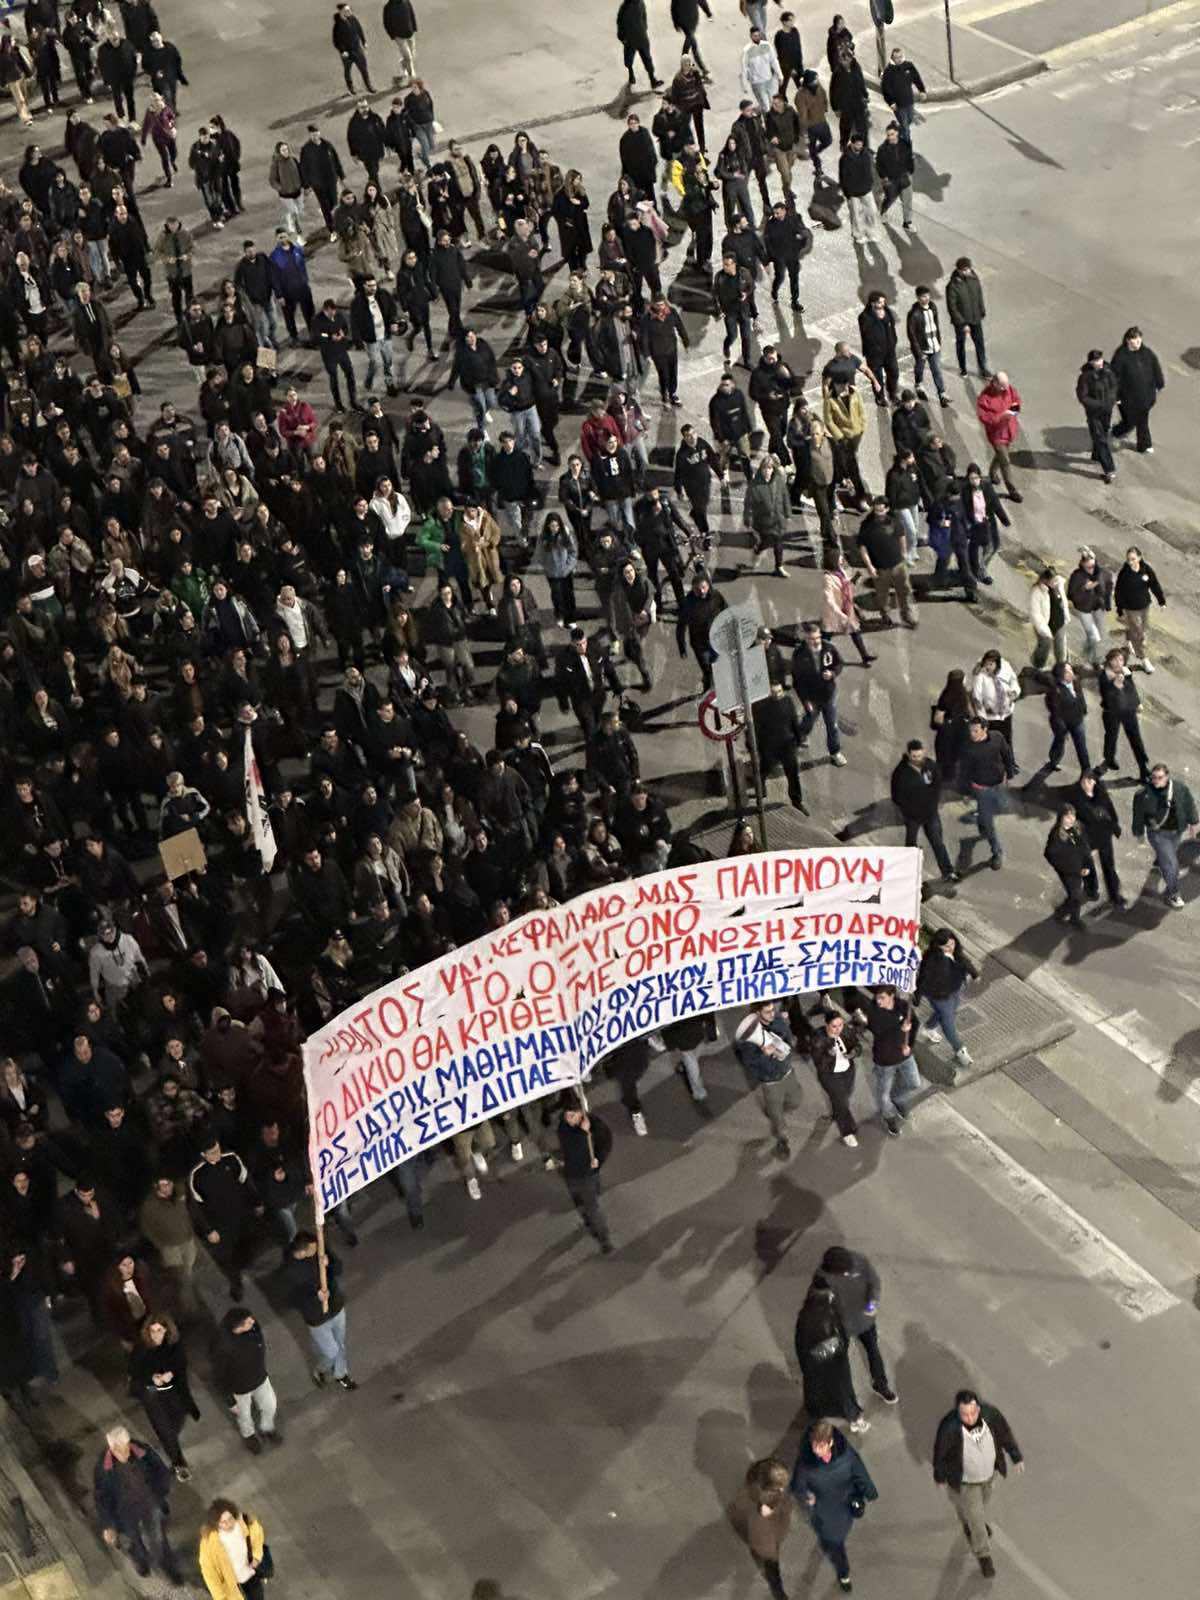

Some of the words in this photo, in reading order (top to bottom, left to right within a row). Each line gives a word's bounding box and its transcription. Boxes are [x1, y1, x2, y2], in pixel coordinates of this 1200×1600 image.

[634, 874, 702, 909] ΜΑΣ
[717, 856, 885, 900] ΠΑΙΡΝΟΥΝ
[342, 1047, 406, 1120] ΔΙΚΙΟ
[413, 1026, 454, 1072] ΘΑ
[458, 994, 567, 1051] ΚΡΙΘΕΙ
[574, 959, 616, 1013] ΜΕ
[624, 918, 785, 977] ΟΡΓΑΝΩΣΗ
[790, 913, 843, 941] ΣΤΟ
[848, 913, 919, 948] ΔΡΟΜ
[413, 1093, 479, 1145] ΣΕΥ.
